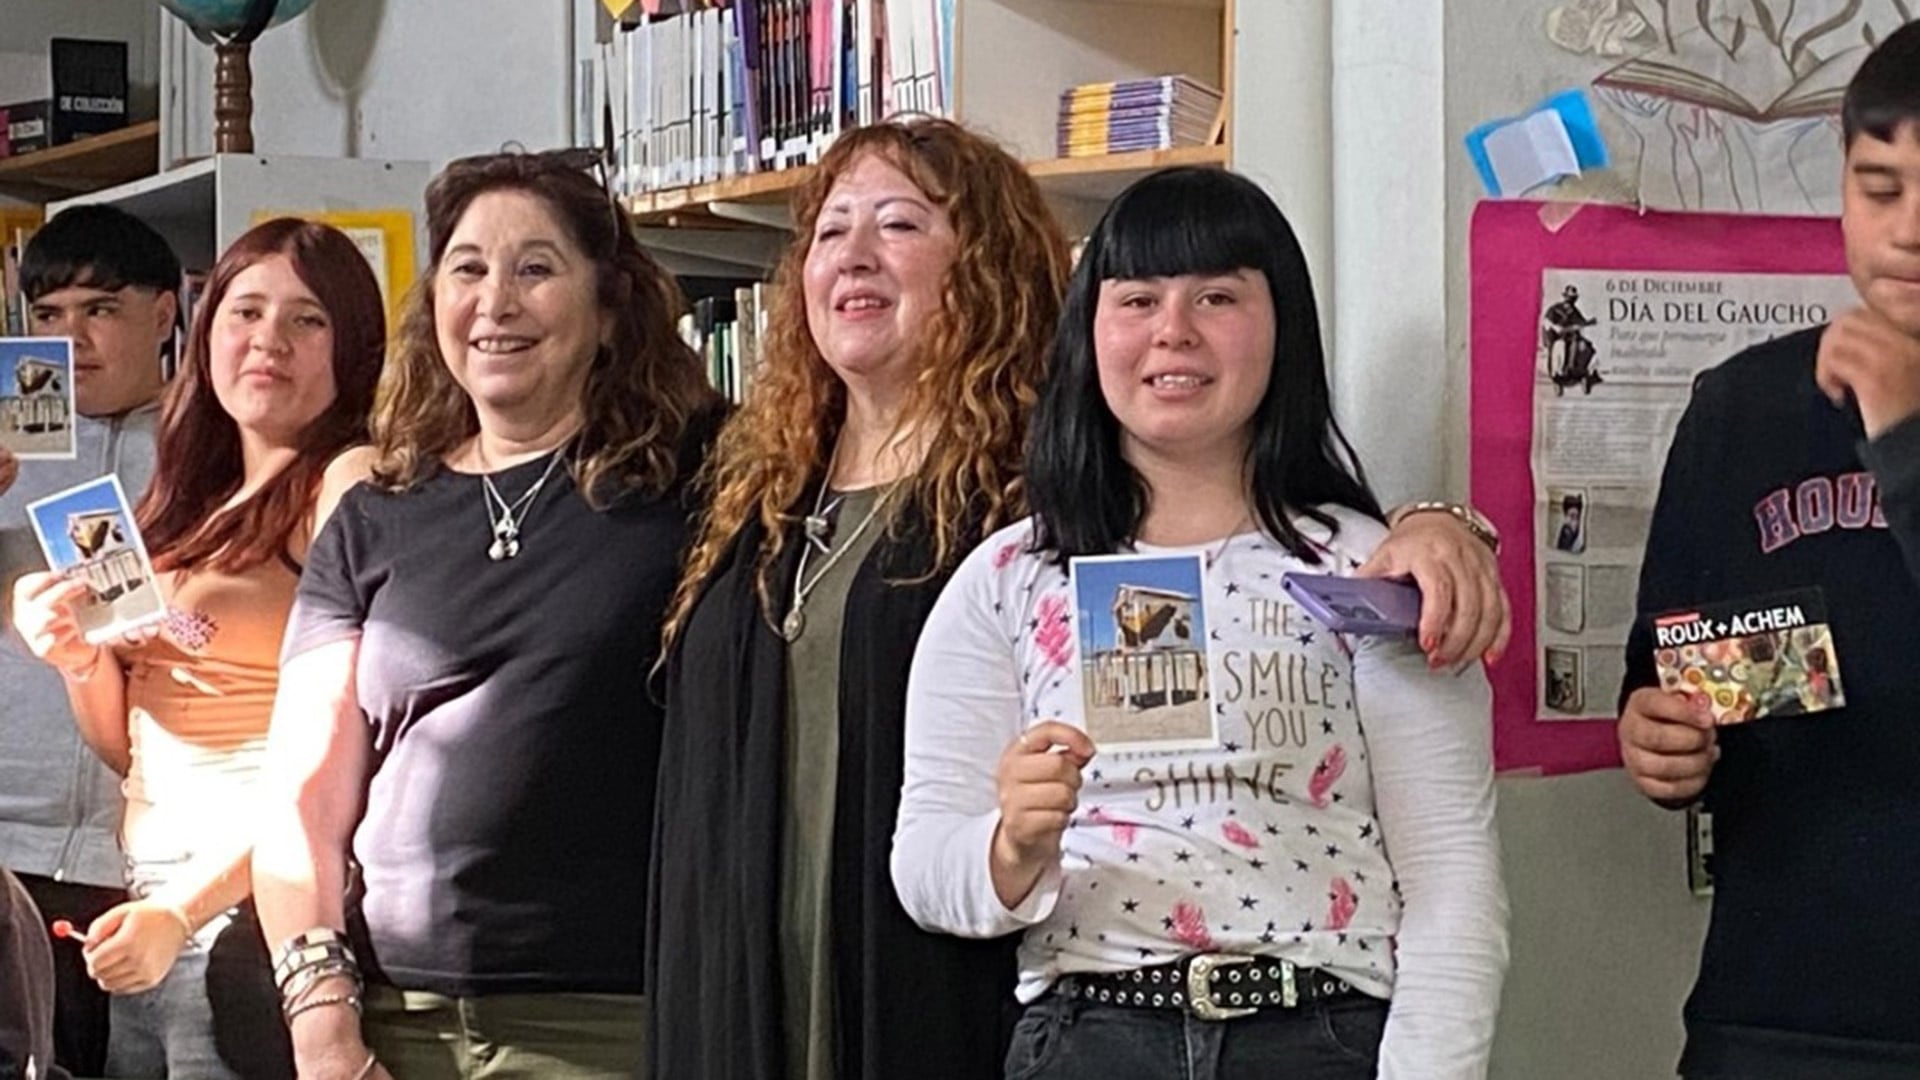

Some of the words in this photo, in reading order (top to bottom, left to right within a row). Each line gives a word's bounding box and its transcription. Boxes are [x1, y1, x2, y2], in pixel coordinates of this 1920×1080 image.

[1606, 279, 1615, 293] 6
[1619, 280, 1637, 293] DE
[1643, 278, 1723, 294] DICIEMBRE
[1609, 296, 1655, 322] DÍA
[1664, 302, 1709, 322] DEL
[1716, 299, 1828, 325] GAUCHO
[1248, 598, 1296, 637] THE
[1223, 651, 1337, 709] SMILE
[1244, 707, 1308, 750] YOU
[1134, 761, 1294, 812] SHINE
